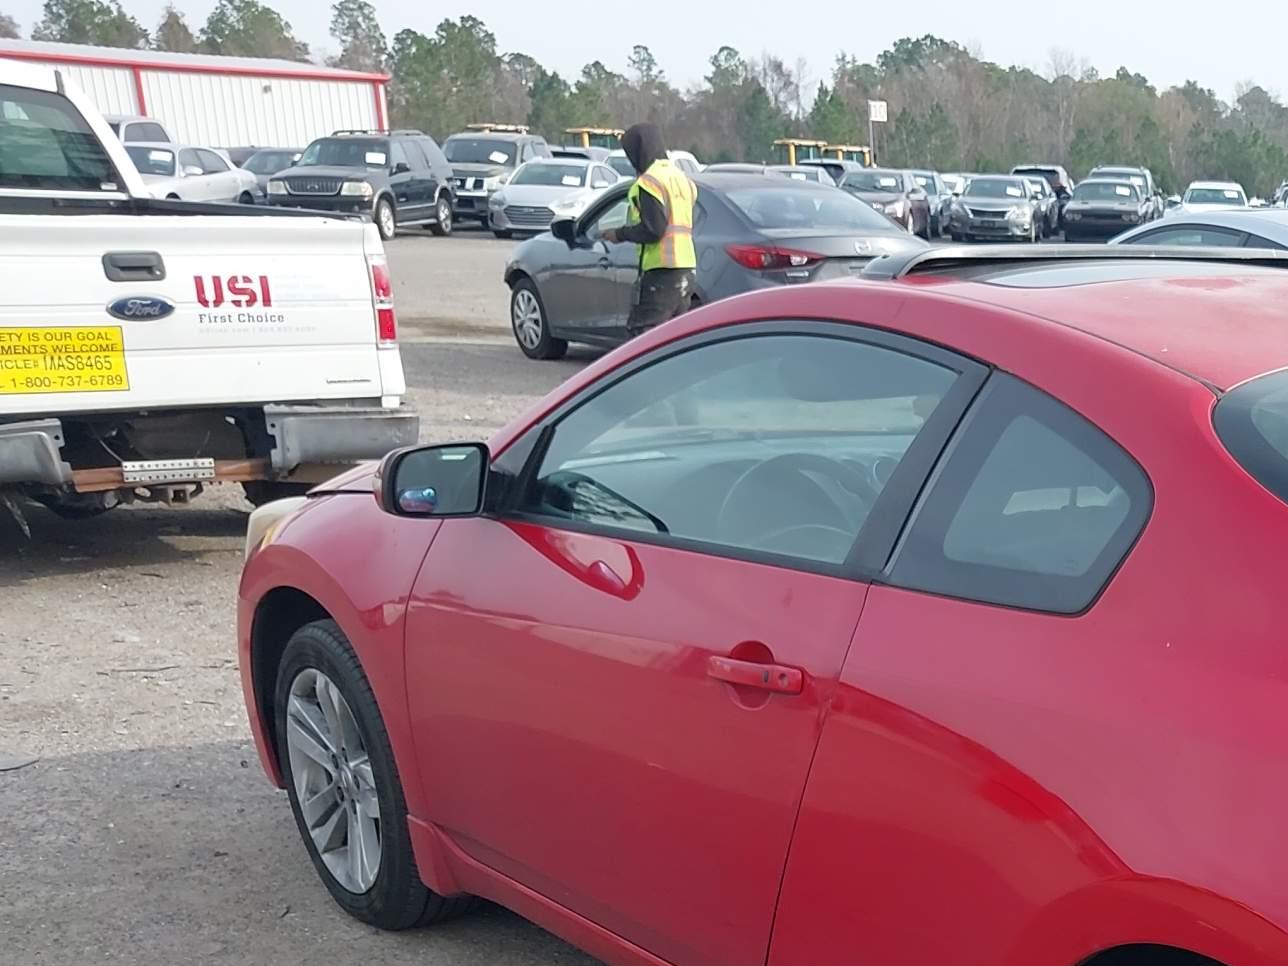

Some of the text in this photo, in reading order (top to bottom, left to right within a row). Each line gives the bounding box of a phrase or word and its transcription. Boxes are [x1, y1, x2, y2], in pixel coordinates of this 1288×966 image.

[193, 275, 273, 308] USI
[123, 299, 161, 316] Ford
[198, 312, 286, 324] First Choice
[0, 331, 113, 343] ETY IS OUR GOAL
[0, 343, 120, 356] MENTS WELCOME
[10, 374, 123, 388] 1-800-737-6789
